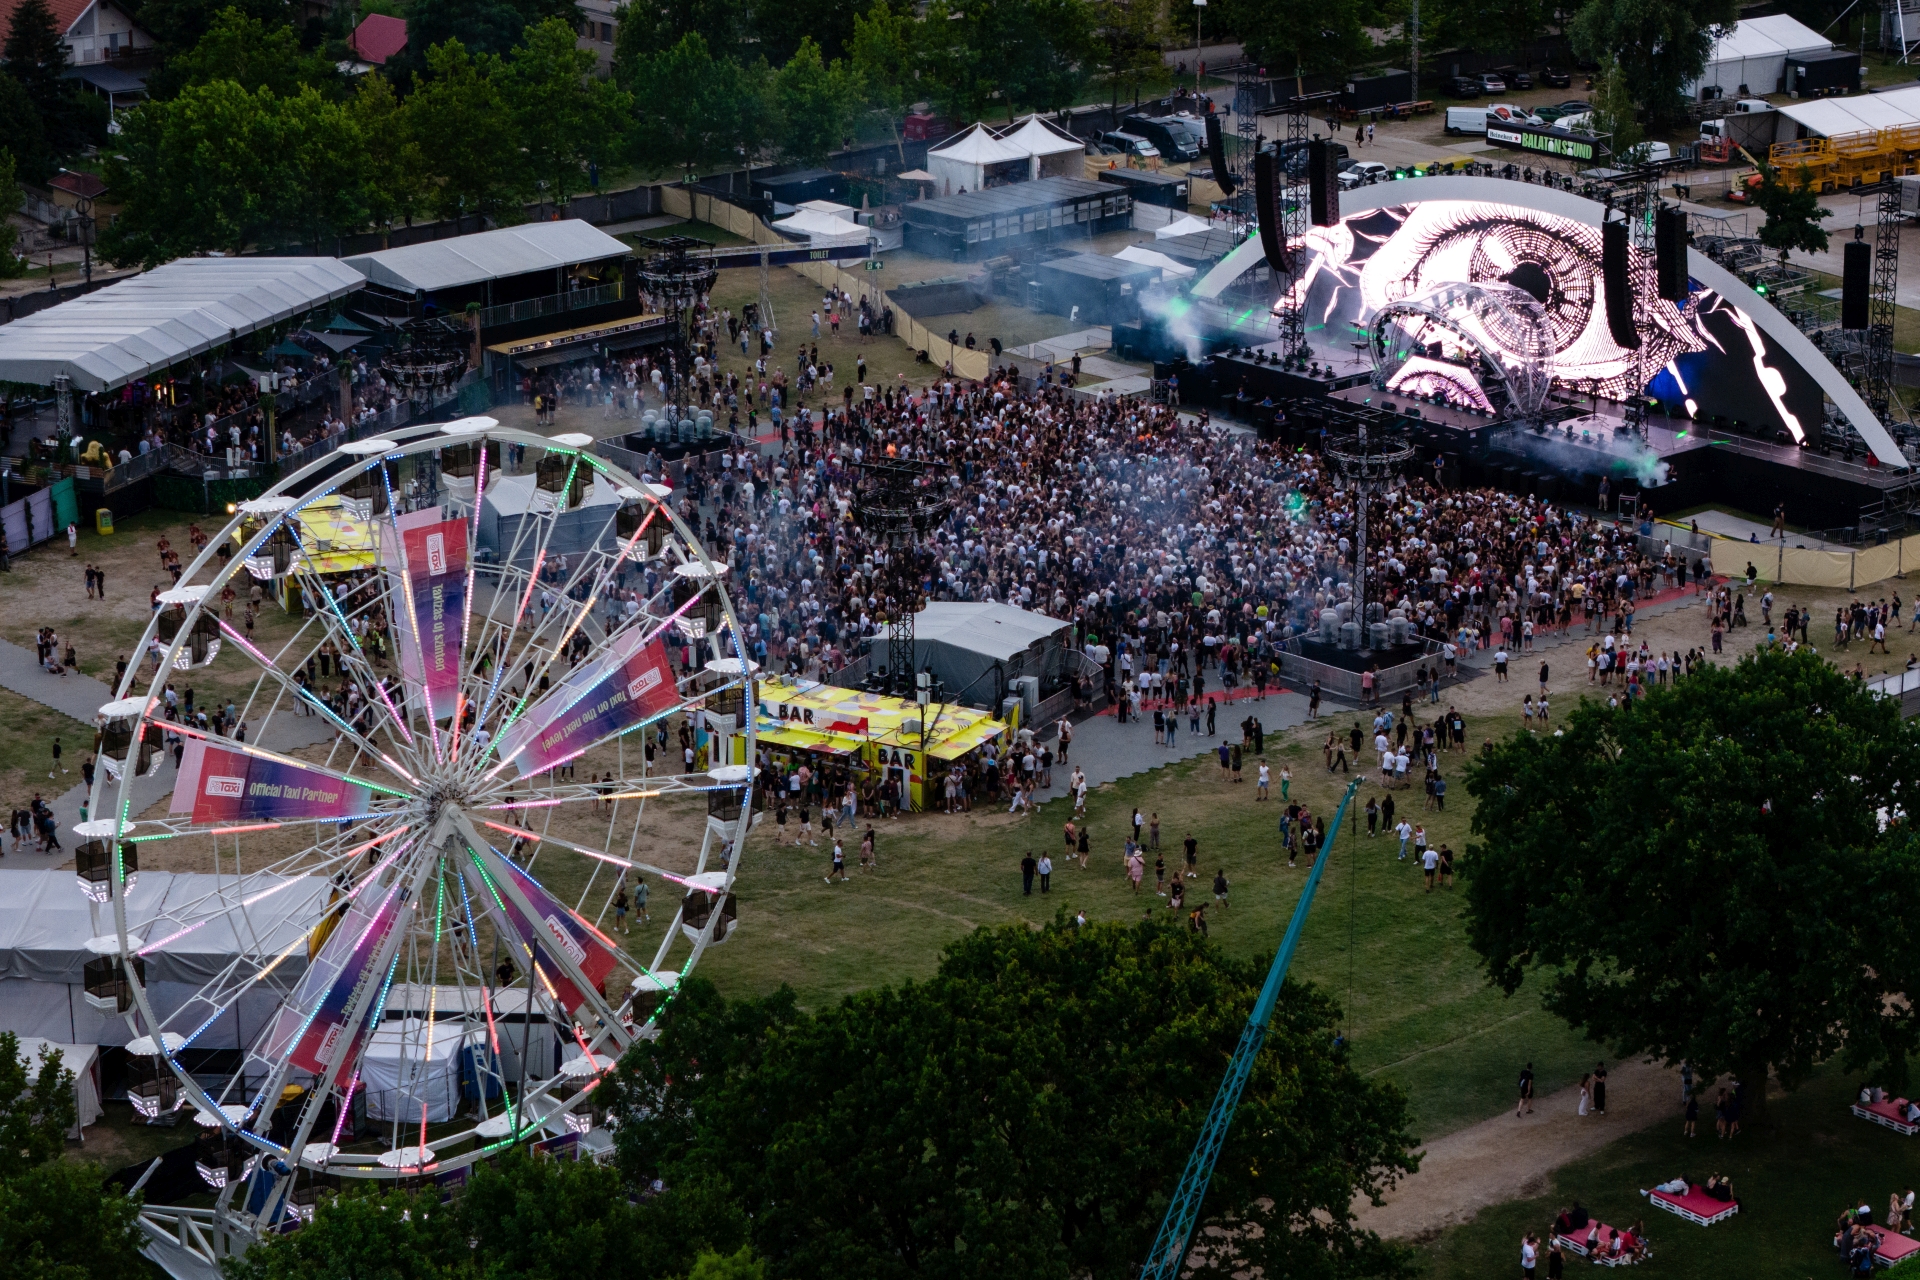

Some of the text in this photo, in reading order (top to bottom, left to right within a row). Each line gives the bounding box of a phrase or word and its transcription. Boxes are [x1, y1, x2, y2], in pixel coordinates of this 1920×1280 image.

[1490, 131, 1512, 140] Heineken
[810, 250, 829, 259] TOILET
[432, 583, 445, 672] Taxizás új szinten
[542, 690, 628, 752] Taxi on the next level
[779, 704, 814, 725] BAR
[878, 748, 914, 770] BAR
[249, 782, 339, 804] Official Taxi Partner
